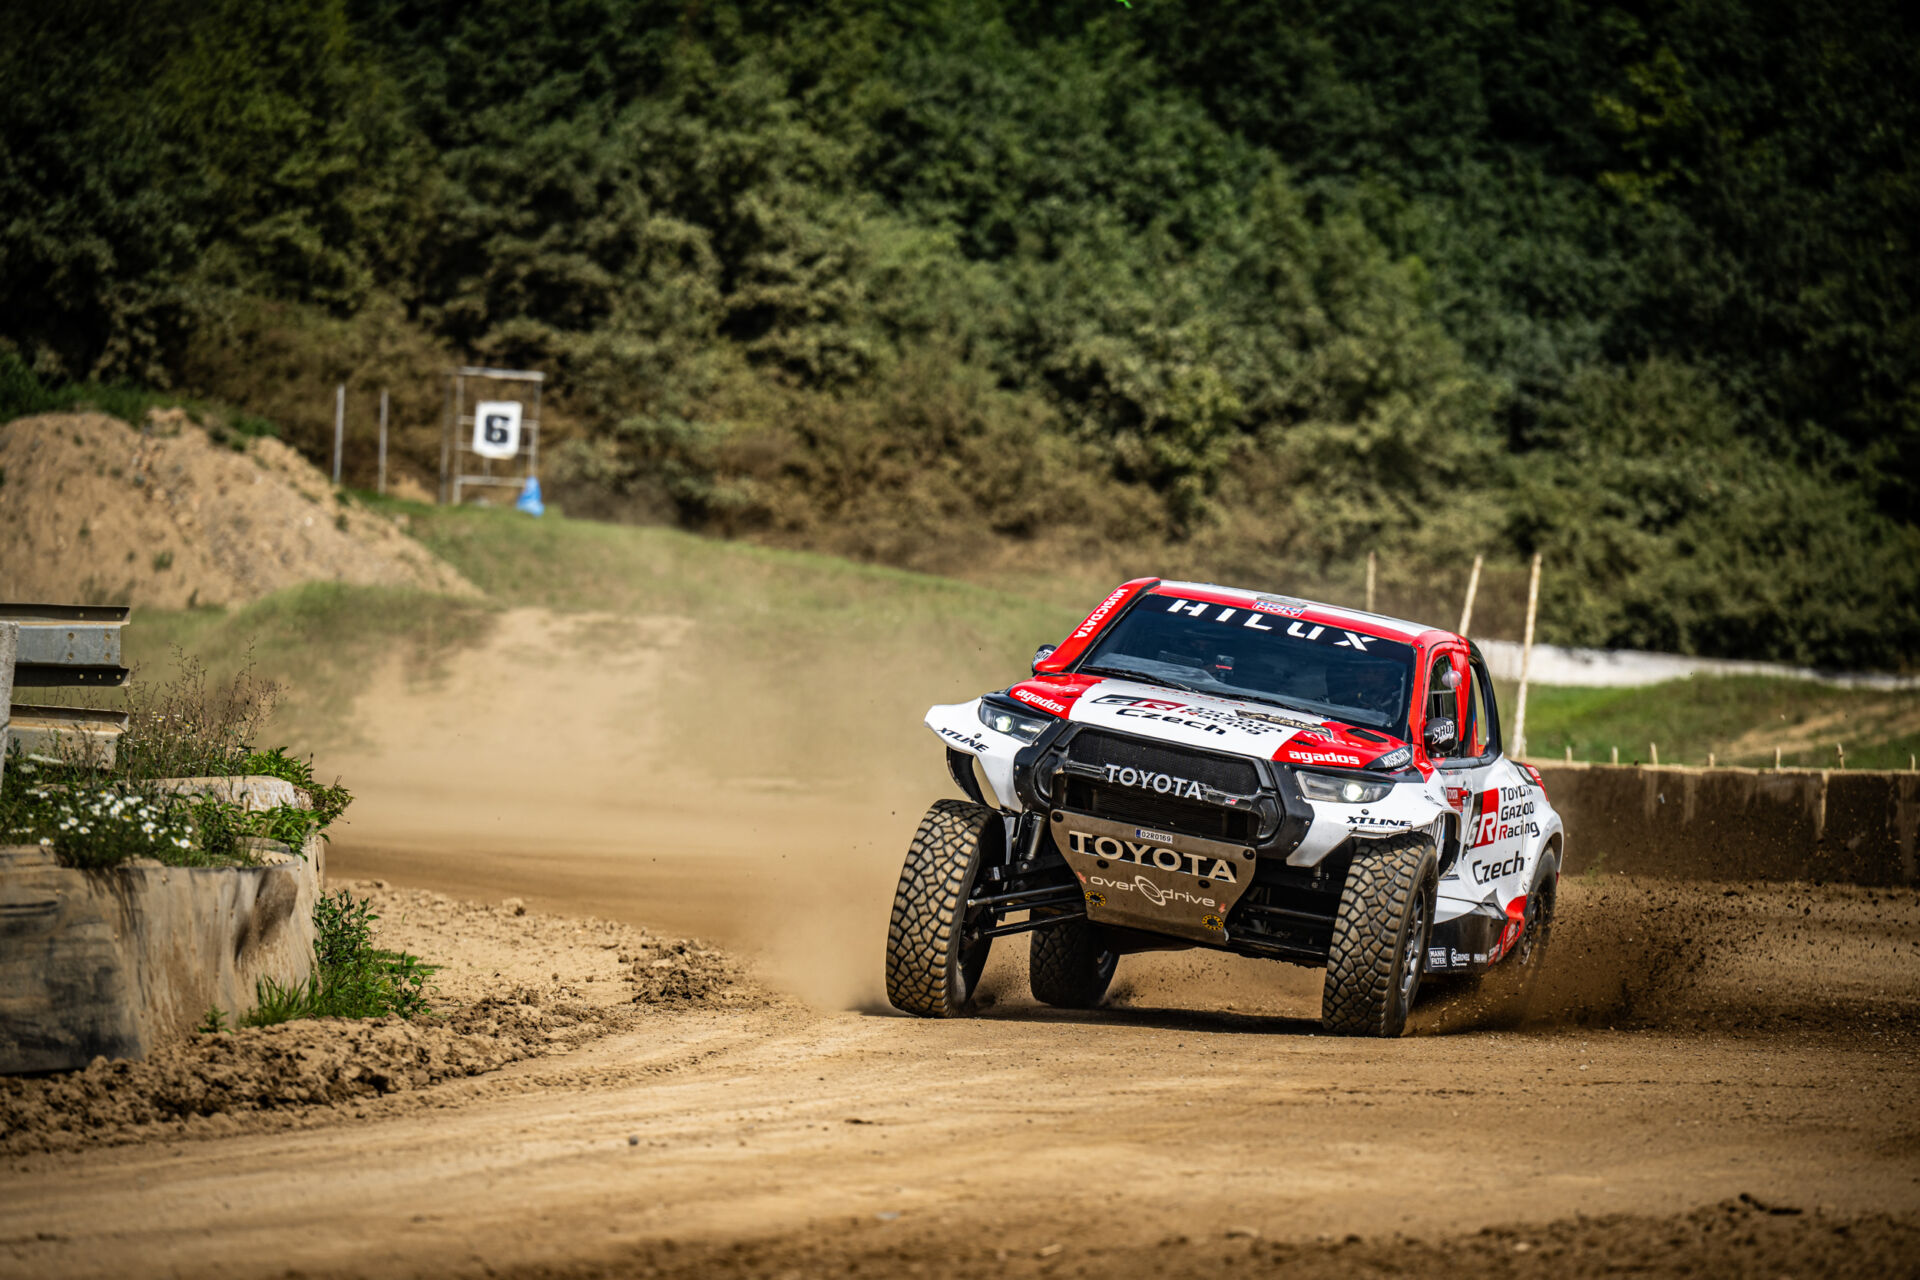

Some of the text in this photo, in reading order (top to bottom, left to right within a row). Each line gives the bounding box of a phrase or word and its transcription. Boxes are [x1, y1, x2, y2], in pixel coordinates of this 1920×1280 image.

[484, 414, 511, 444] 6
[1074, 588, 1128, 638] MUSICDATA
[1253, 604, 1300, 618] MOLY
[1167, 599, 1378, 651] HILUX
[1015, 689, 1067, 713] agados
[1116, 708, 1226, 735] Czech
[937, 727, 990, 752] XTLINE
[1288, 750, 1360, 766] agados
[1106, 763, 1203, 800] TOYOTA
[1500, 784, 1534, 802] TOYOTA
[1346, 816, 1412, 826] XTLINE
[1500, 801, 1535, 821] GAZOO
[1499, 821, 1540, 840] Racing
[1069, 830, 1237, 883] TOYOTA
[1472, 850, 1525, 885] Czech
[1430, 949, 1445, 958] MANN
[1431, 957, 1447, 965] FILTER
